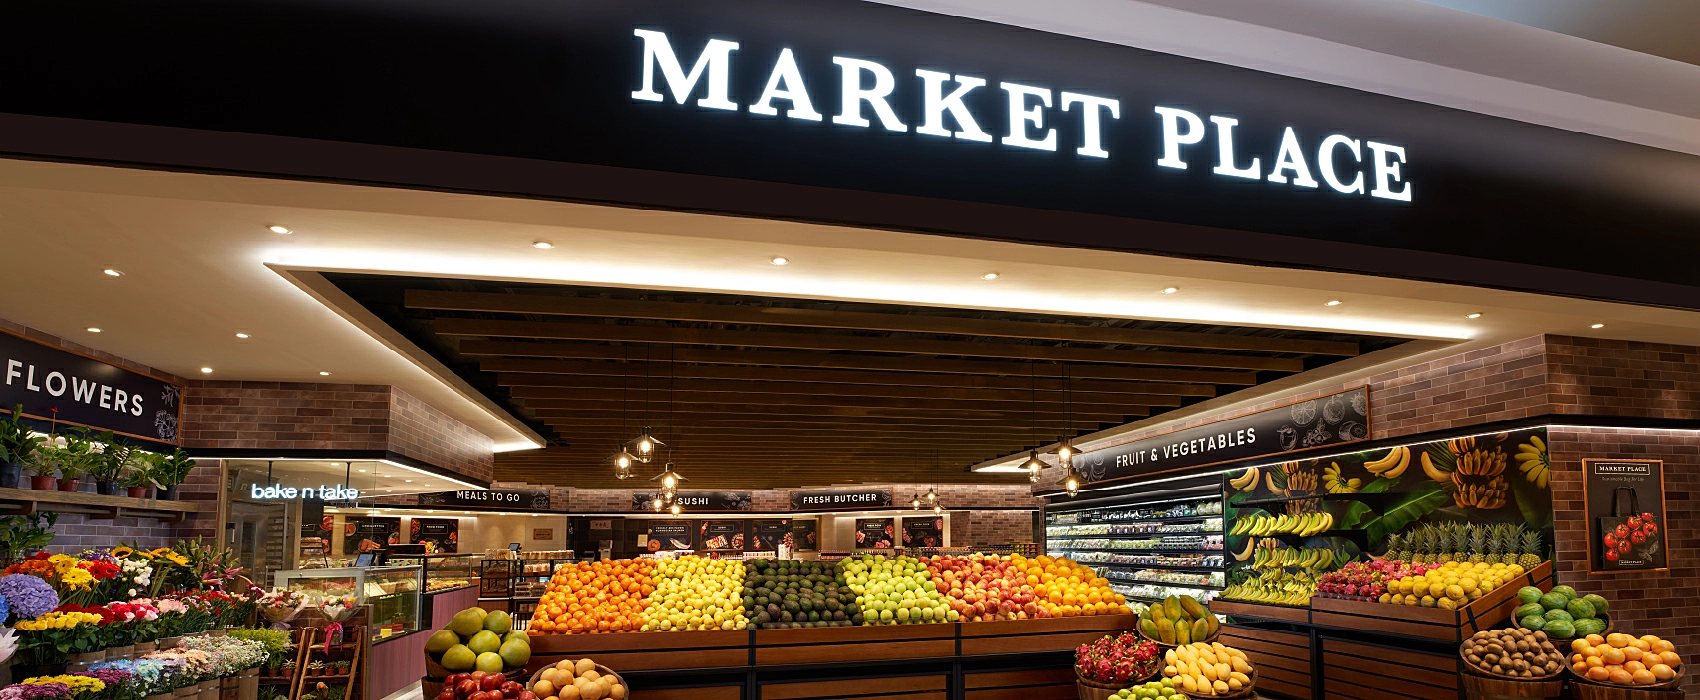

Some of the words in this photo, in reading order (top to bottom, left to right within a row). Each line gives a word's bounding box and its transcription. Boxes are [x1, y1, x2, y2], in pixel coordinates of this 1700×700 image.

[631, 28, 1121, 159] MARKET
[1154, 105, 1414, 202] PLACE
[6, 358, 144, 417] FLOWERS
[1116, 451, 1145, 468] FRUIT
[1150, 449, 1157, 461] &
[1163, 428, 1256, 459] VEGETABLES
[251, 483, 298, 499] bake
[301, 487, 314, 499] n
[319, 483, 359, 500] take
[456, 490, 487, 501] MEALS
[490, 492, 503, 501] TO
[506, 493, 520, 502] GO
[803, 496, 831, 505] FRESH
[834, 493, 877, 503] BUTCHER
[678, 497, 709, 505] SUSHI
